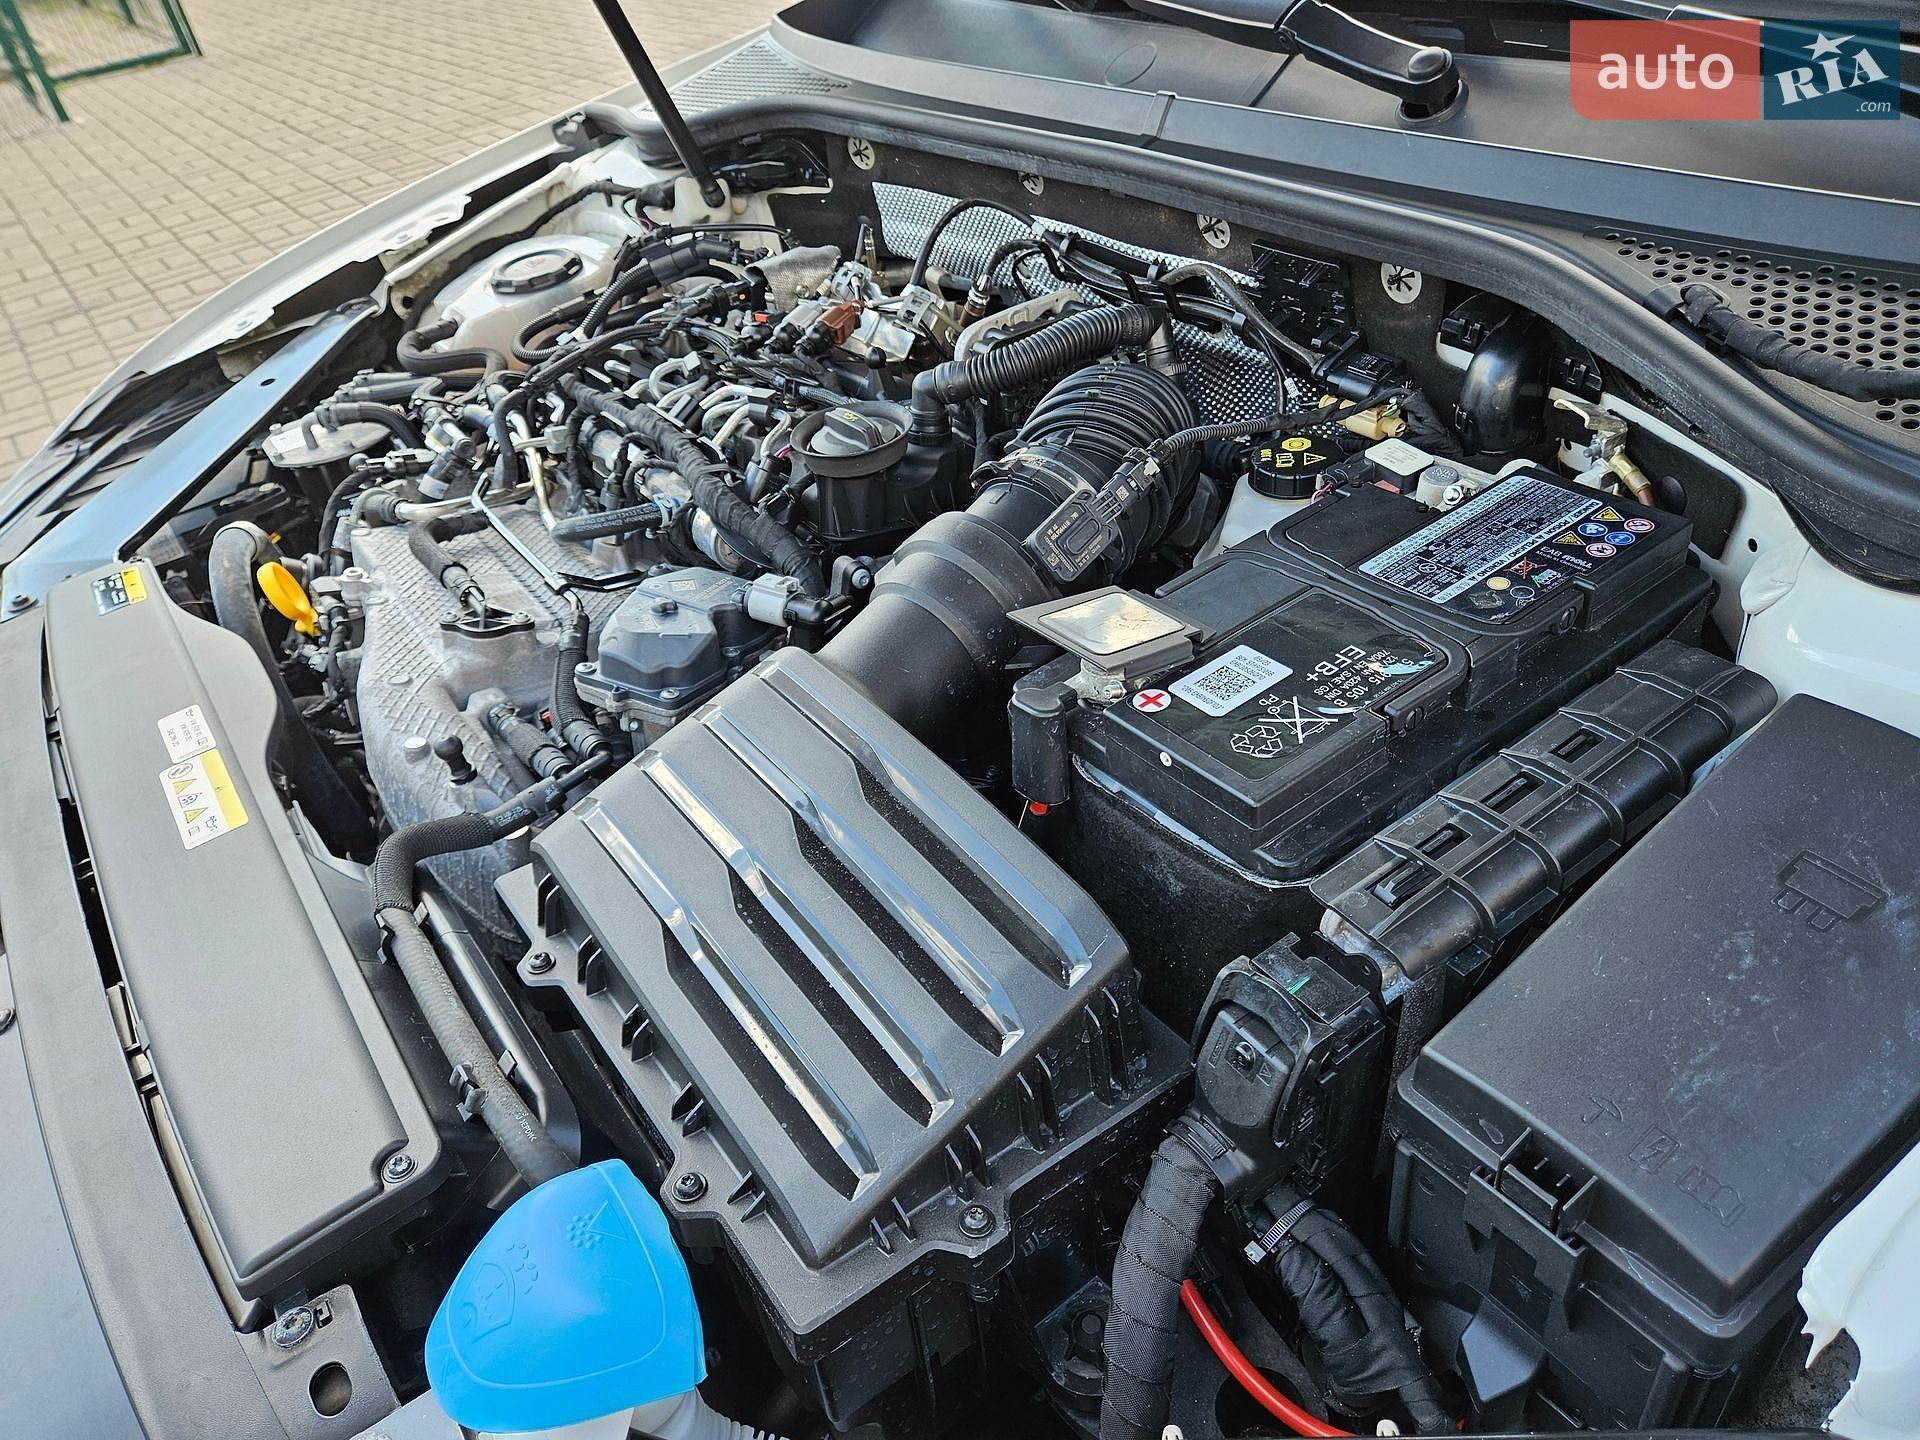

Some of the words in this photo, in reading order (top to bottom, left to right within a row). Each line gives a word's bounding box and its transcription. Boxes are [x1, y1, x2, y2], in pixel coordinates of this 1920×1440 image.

[1542, 519, 1571, 535] POISON
[1506, 538, 1539, 557] PELIGRO
[1475, 558, 1506, 577] VENENO
[1367, 650, 1390, 661] 700A
[1306, 645, 1366, 681] EFB+
[1353, 660, 1367, 671] EN
[1331, 671, 1352, 685] SAE
[1341, 675, 1361, 689] 420A
[1368, 671, 1391, 685] 915
[1314, 685, 1329, 695] GS
[1324, 688, 1342, 701] DIN
[1346, 685, 1369, 700] 105
[1259, 694, 1279, 705] Pb
[1334, 699, 1348, 707] B
